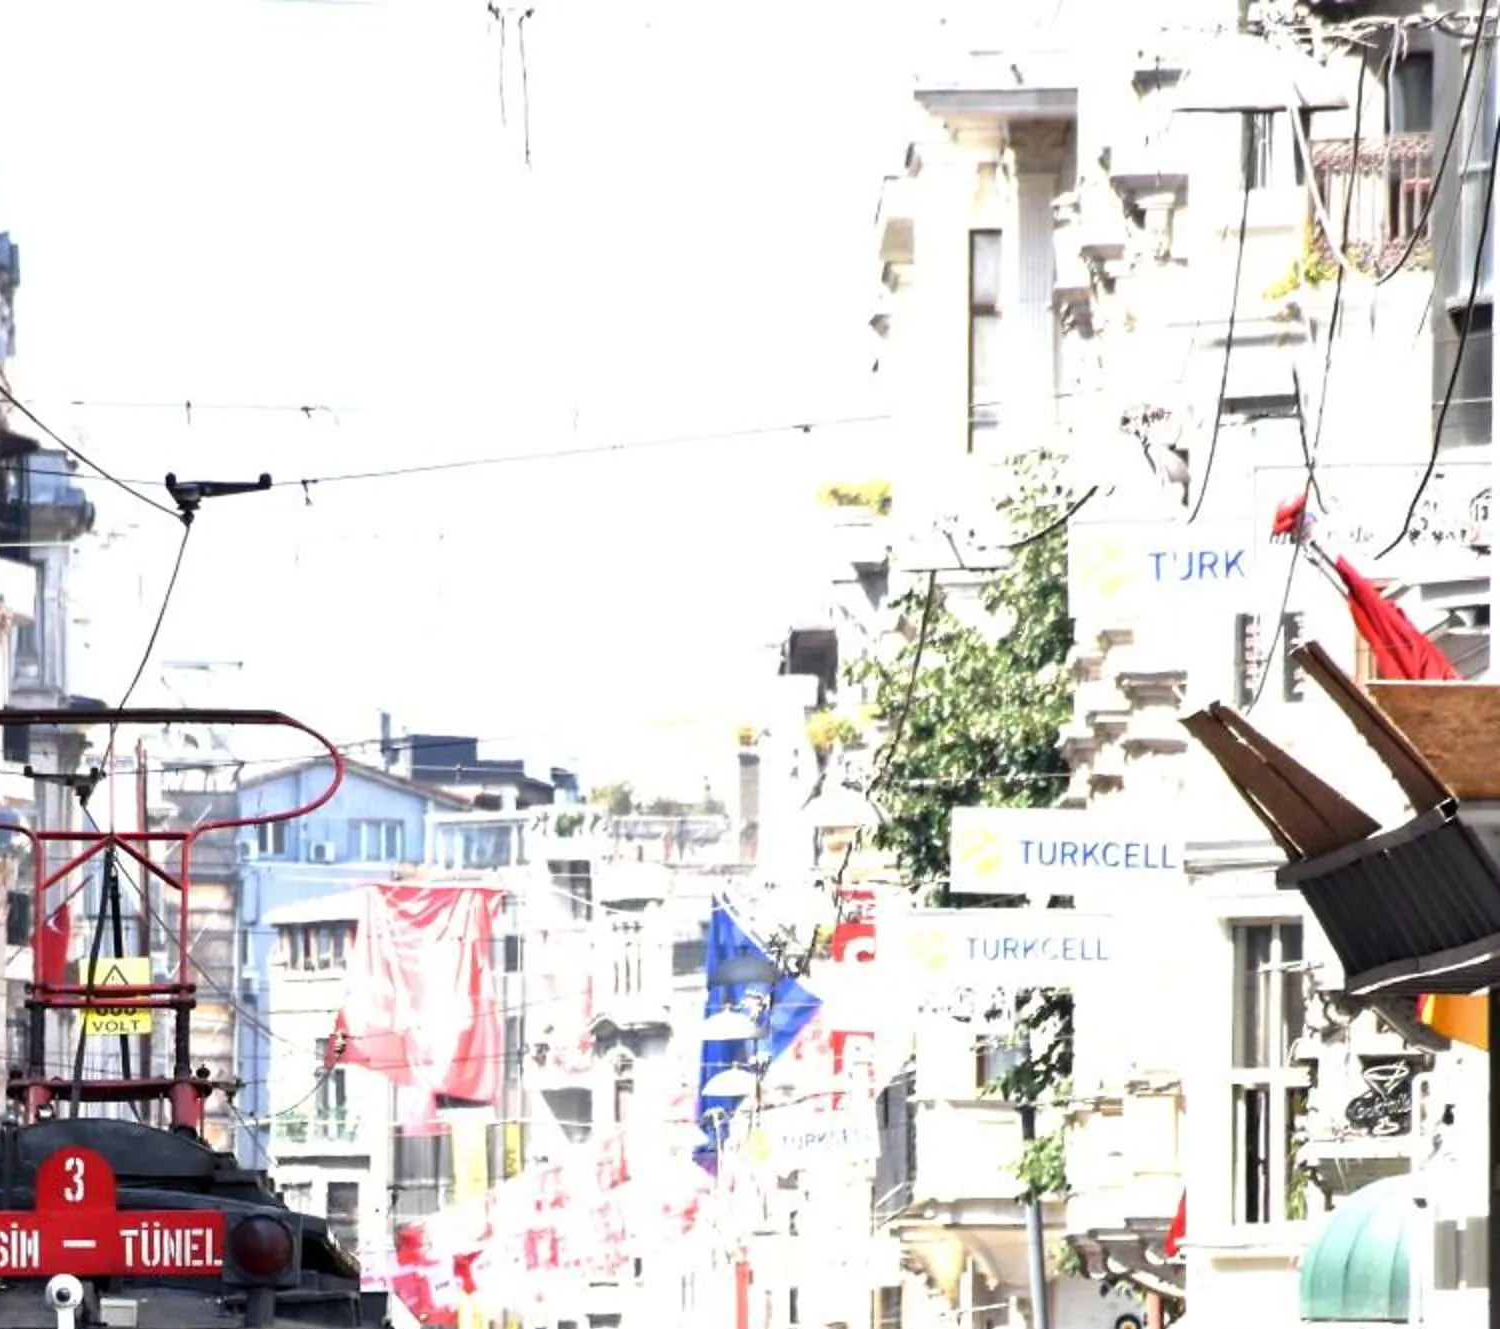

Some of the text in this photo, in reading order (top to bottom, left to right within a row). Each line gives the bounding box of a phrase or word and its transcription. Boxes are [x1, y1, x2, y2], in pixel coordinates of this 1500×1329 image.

[1147, 549, 1246, 581] TURK
[1020, 841, 1177, 869] TURKCELL
[966, 937, 1110, 961] TURKCELL
[91, 1019, 141, 1033] VOLT
[63, 1156, 87, 1203] 3
[119, 1221, 224, 1268] TÜNEL
